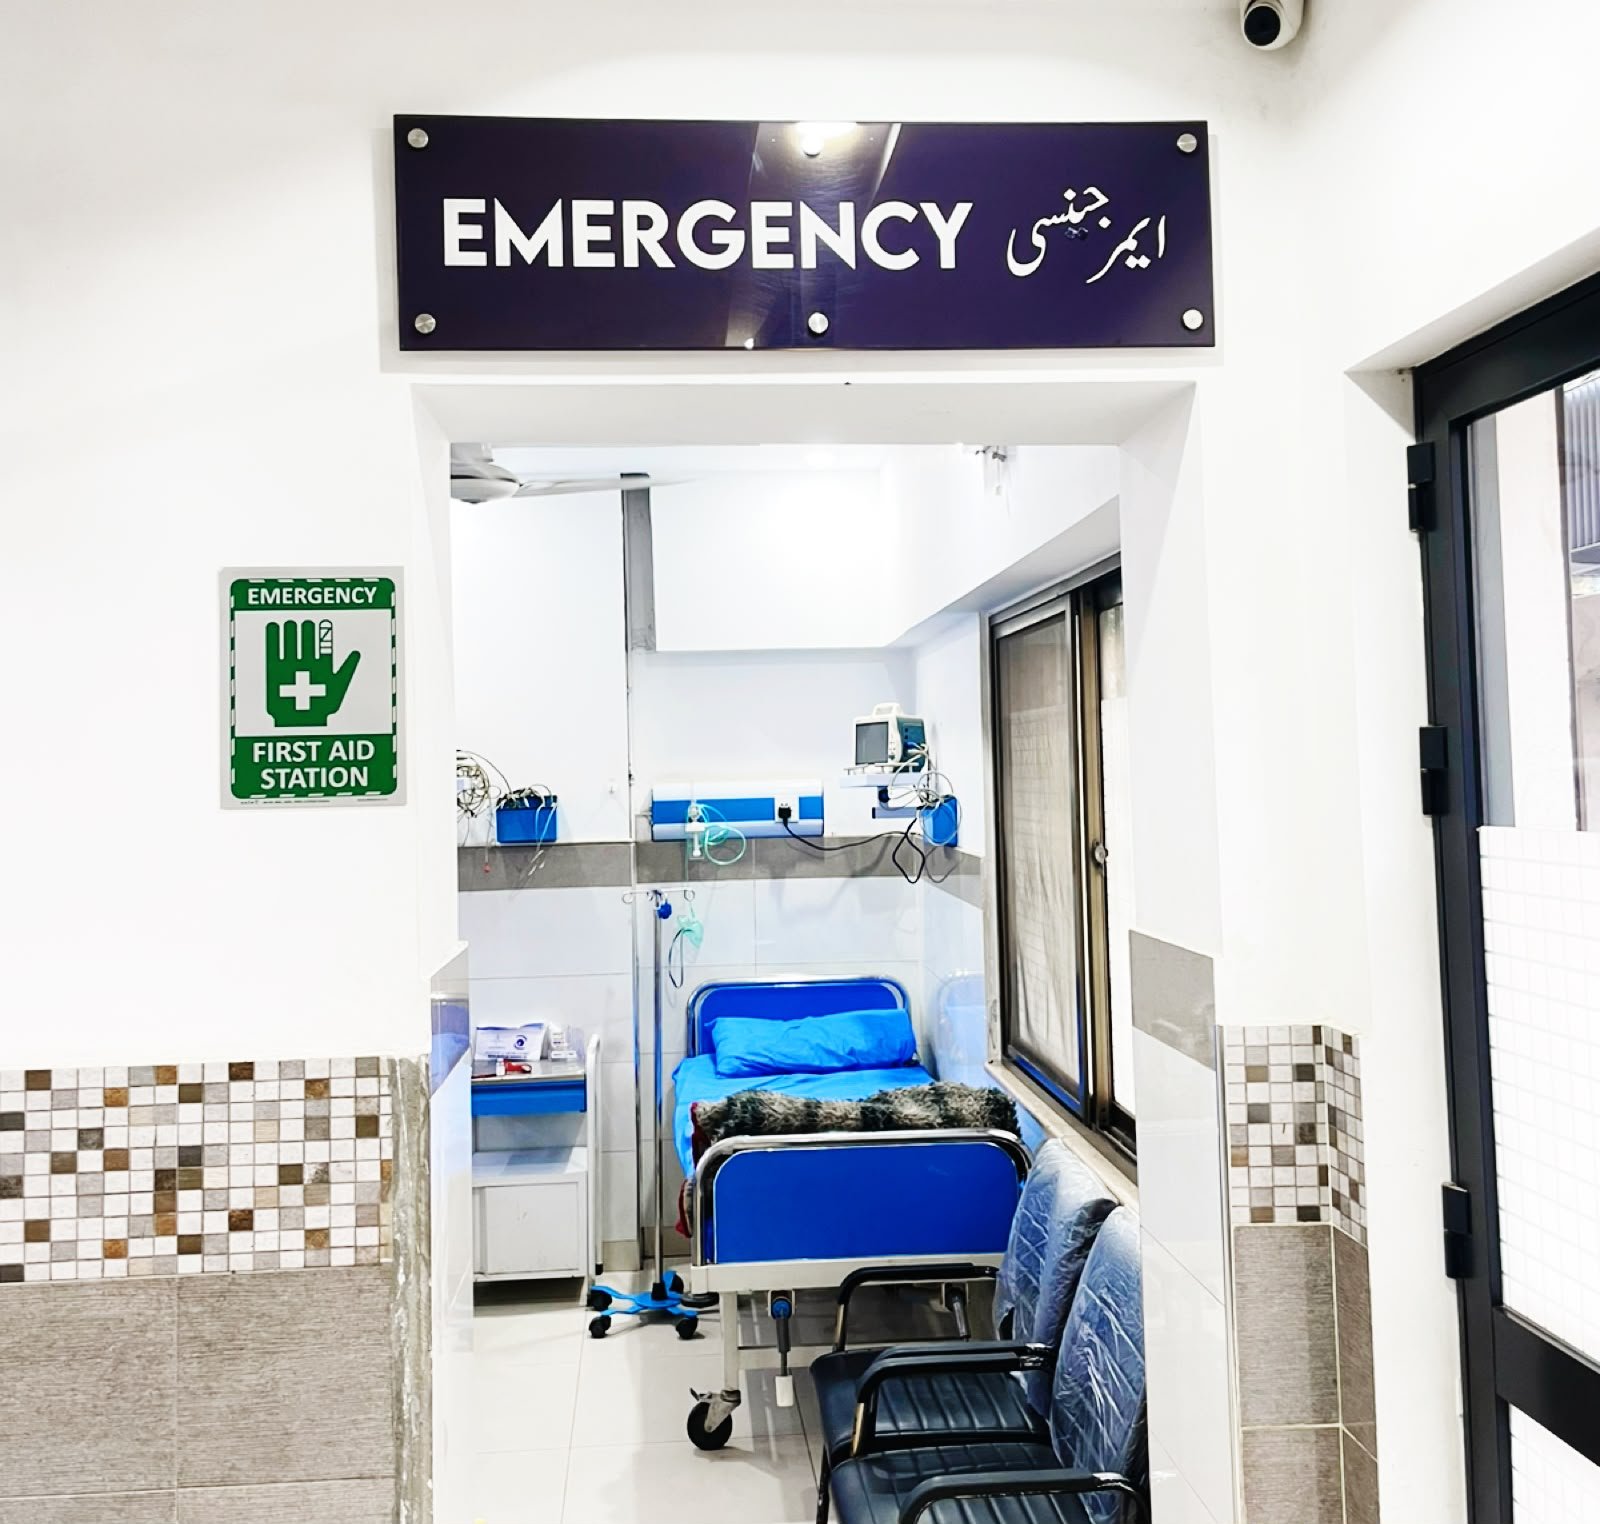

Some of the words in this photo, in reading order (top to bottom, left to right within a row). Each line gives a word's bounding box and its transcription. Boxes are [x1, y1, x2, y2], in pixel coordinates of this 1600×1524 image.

[442, 197, 972, 271] EMERGENCY
[1006, 186, 1166, 284] ایمرجنسی
[247, 586, 377, 605] EMERGENCY
[252, 741, 322, 763] FIRST
[328, 740, 375, 761] AID
[260, 766, 368, 790] STATION
